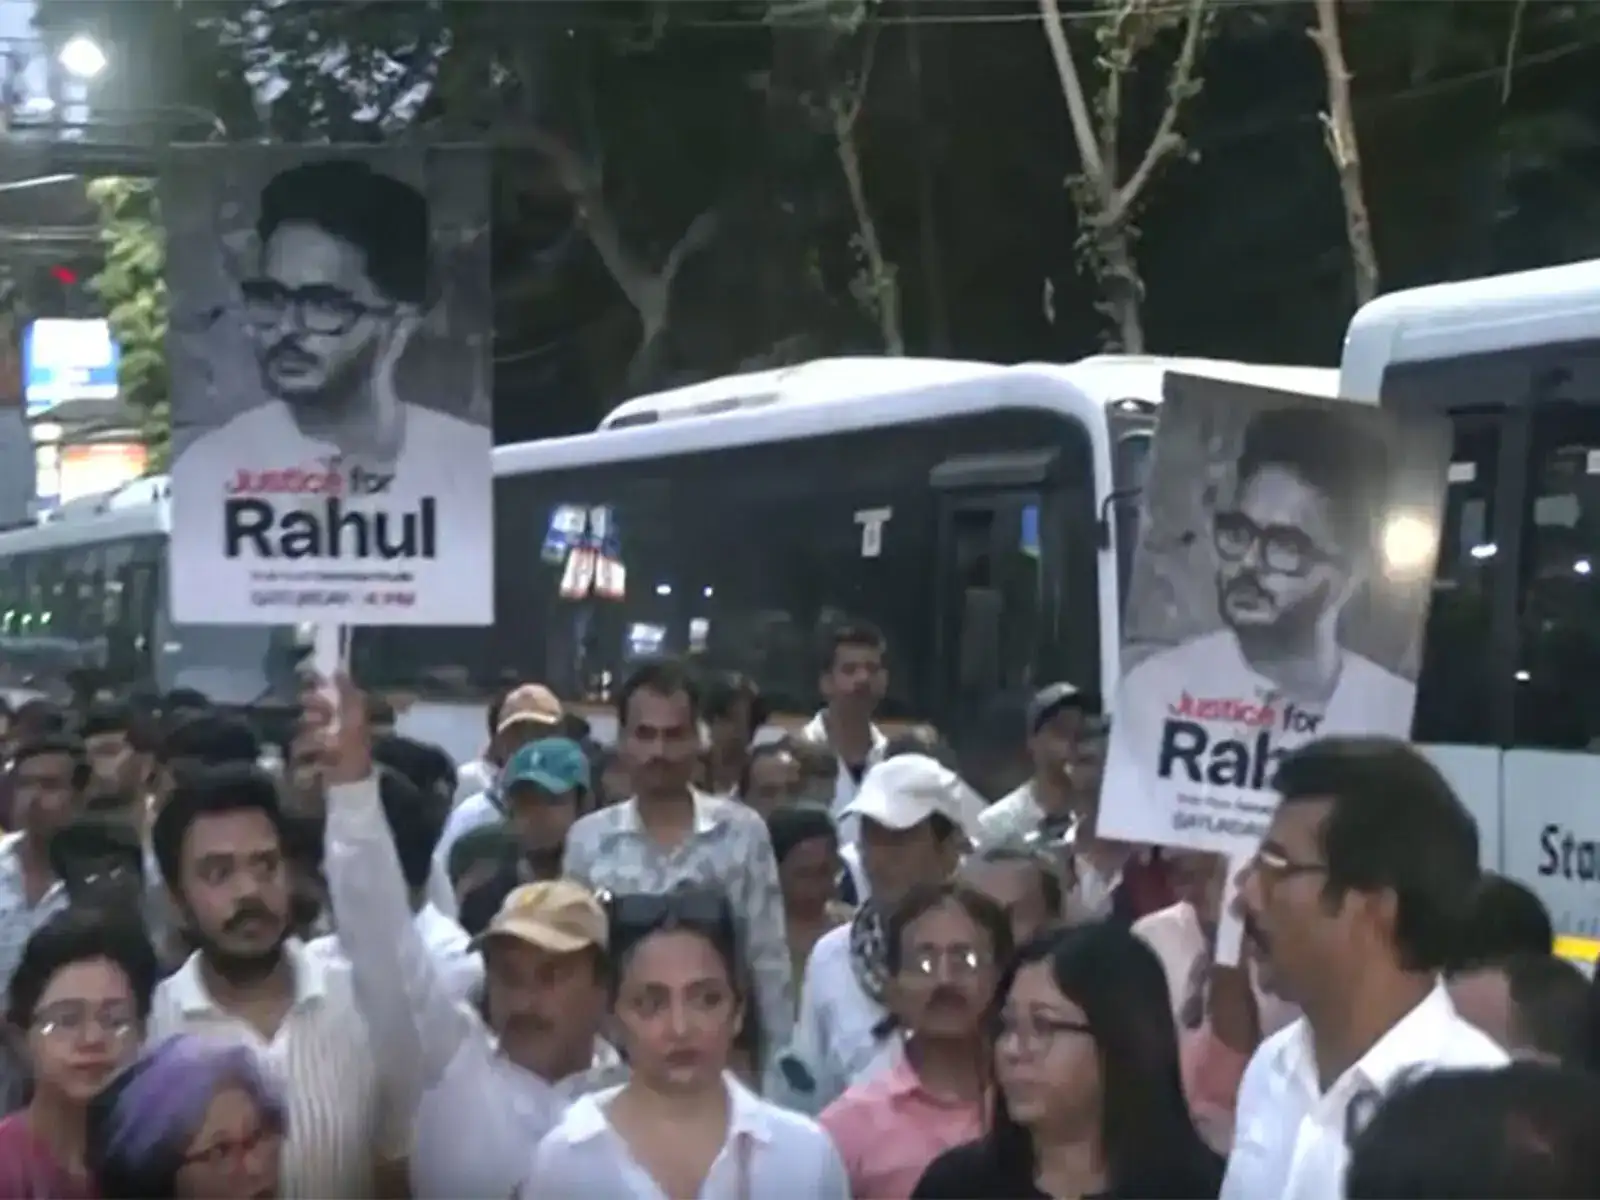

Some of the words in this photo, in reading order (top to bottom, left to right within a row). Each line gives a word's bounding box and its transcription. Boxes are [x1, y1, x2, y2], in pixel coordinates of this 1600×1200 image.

[225, 467, 342, 494] Justice
[350, 464, 395, 494] for
[223, 496, 436, 560] Rahul
[1167, 689, 1276, 726] Justice
[1282, 702, 1324, 733] for
[1158, 717, 1284, 791] Rah
[1538, 823, 1600, 883] Sta
